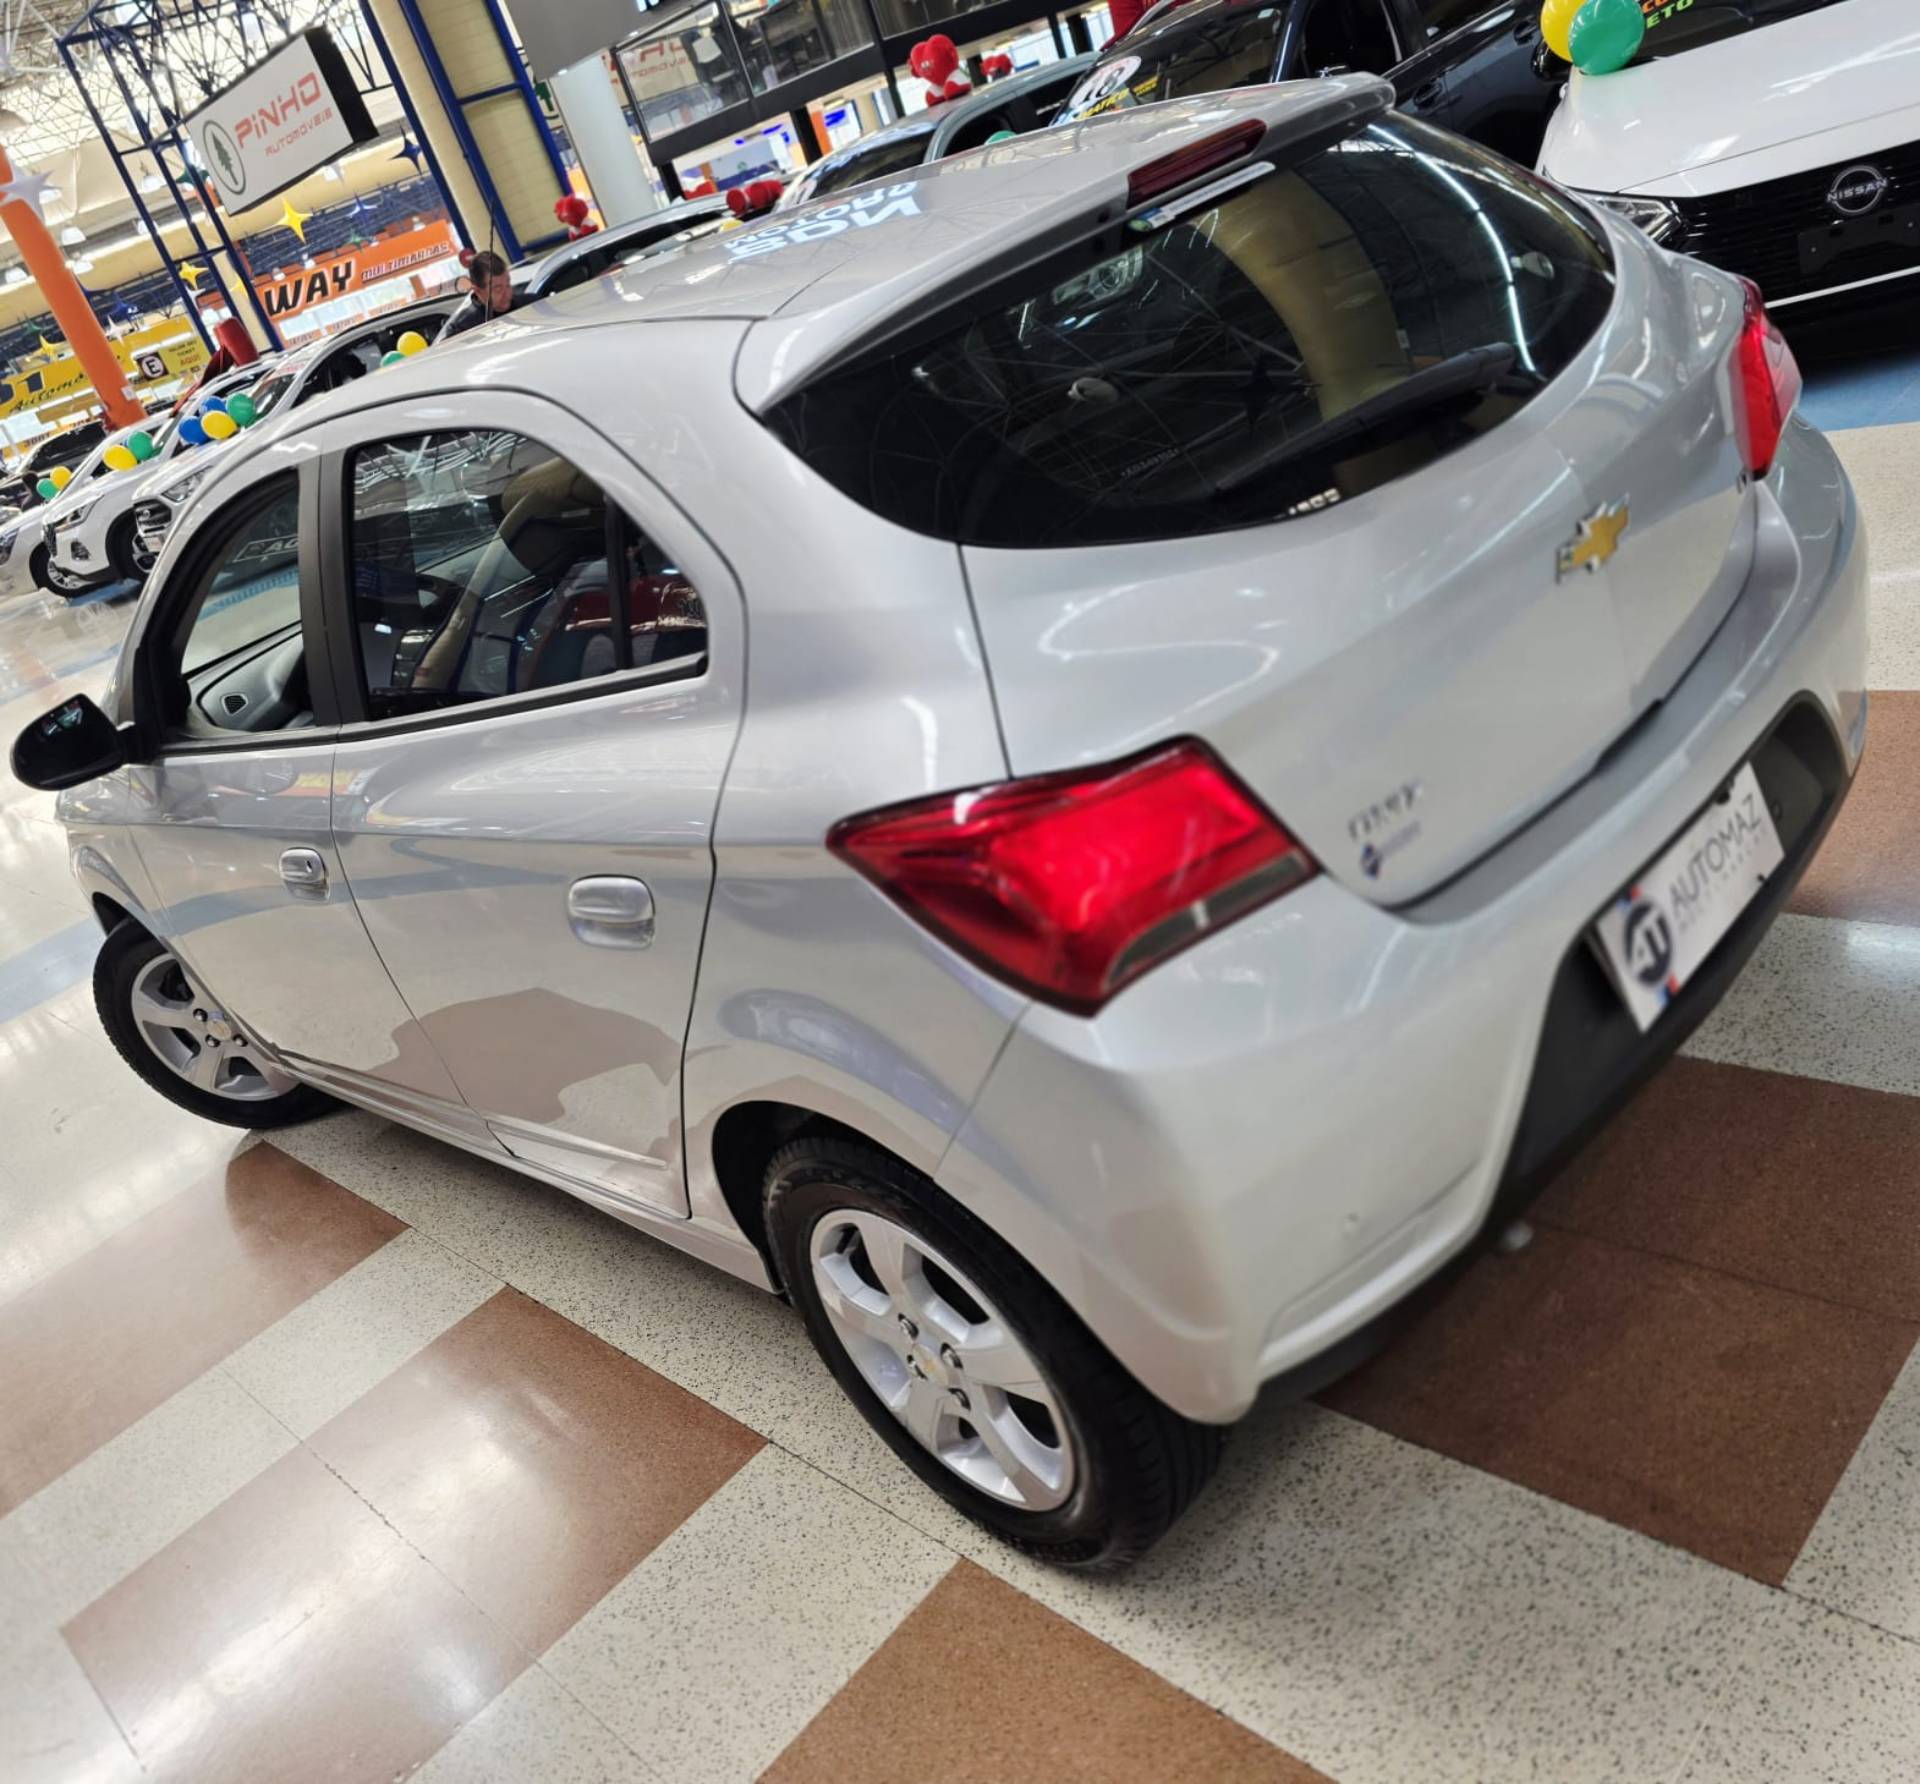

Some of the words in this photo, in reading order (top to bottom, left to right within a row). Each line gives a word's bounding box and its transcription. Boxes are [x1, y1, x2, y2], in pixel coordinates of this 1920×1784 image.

[1646, 0, 1693, 29] ETO
[265, 107, 333, 157] AUTOMOVEIS
[1826, 177, 1887, 203] NISSAN
[264, 260, 353, 317] WAY
[145, 358, 161, 376] E
[1669, 792, 1761, 915] AUTOMAZ
